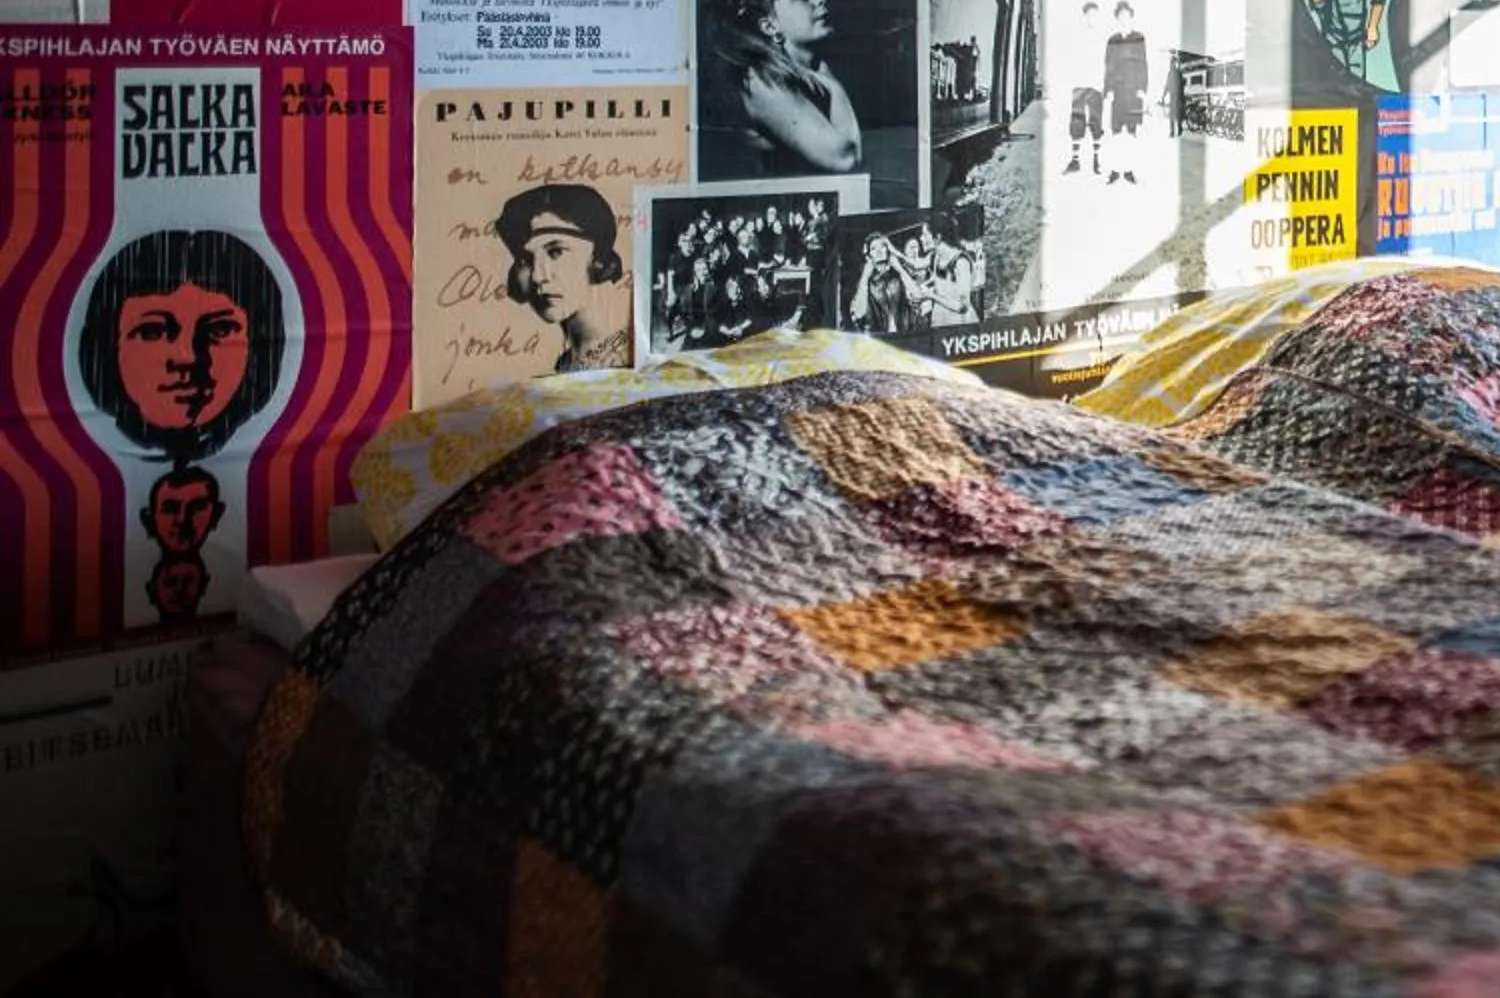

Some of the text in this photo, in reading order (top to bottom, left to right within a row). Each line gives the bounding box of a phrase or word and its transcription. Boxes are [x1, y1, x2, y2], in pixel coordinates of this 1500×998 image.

[150, 34, 260, 57] TYÖVÄEN
[265, 33, 385, 57] NÄYTTÄMÖ
[436, 98, 671, 122] PAJUPILLI
[1257, 125, 1343, 159] KOLMEN
[1256, 169, 1339, 203] PENNIN
[1251, 213, 1345, 250] OOPPERA
[942, 322, 1066, 355] YKSPIHLAJAN
